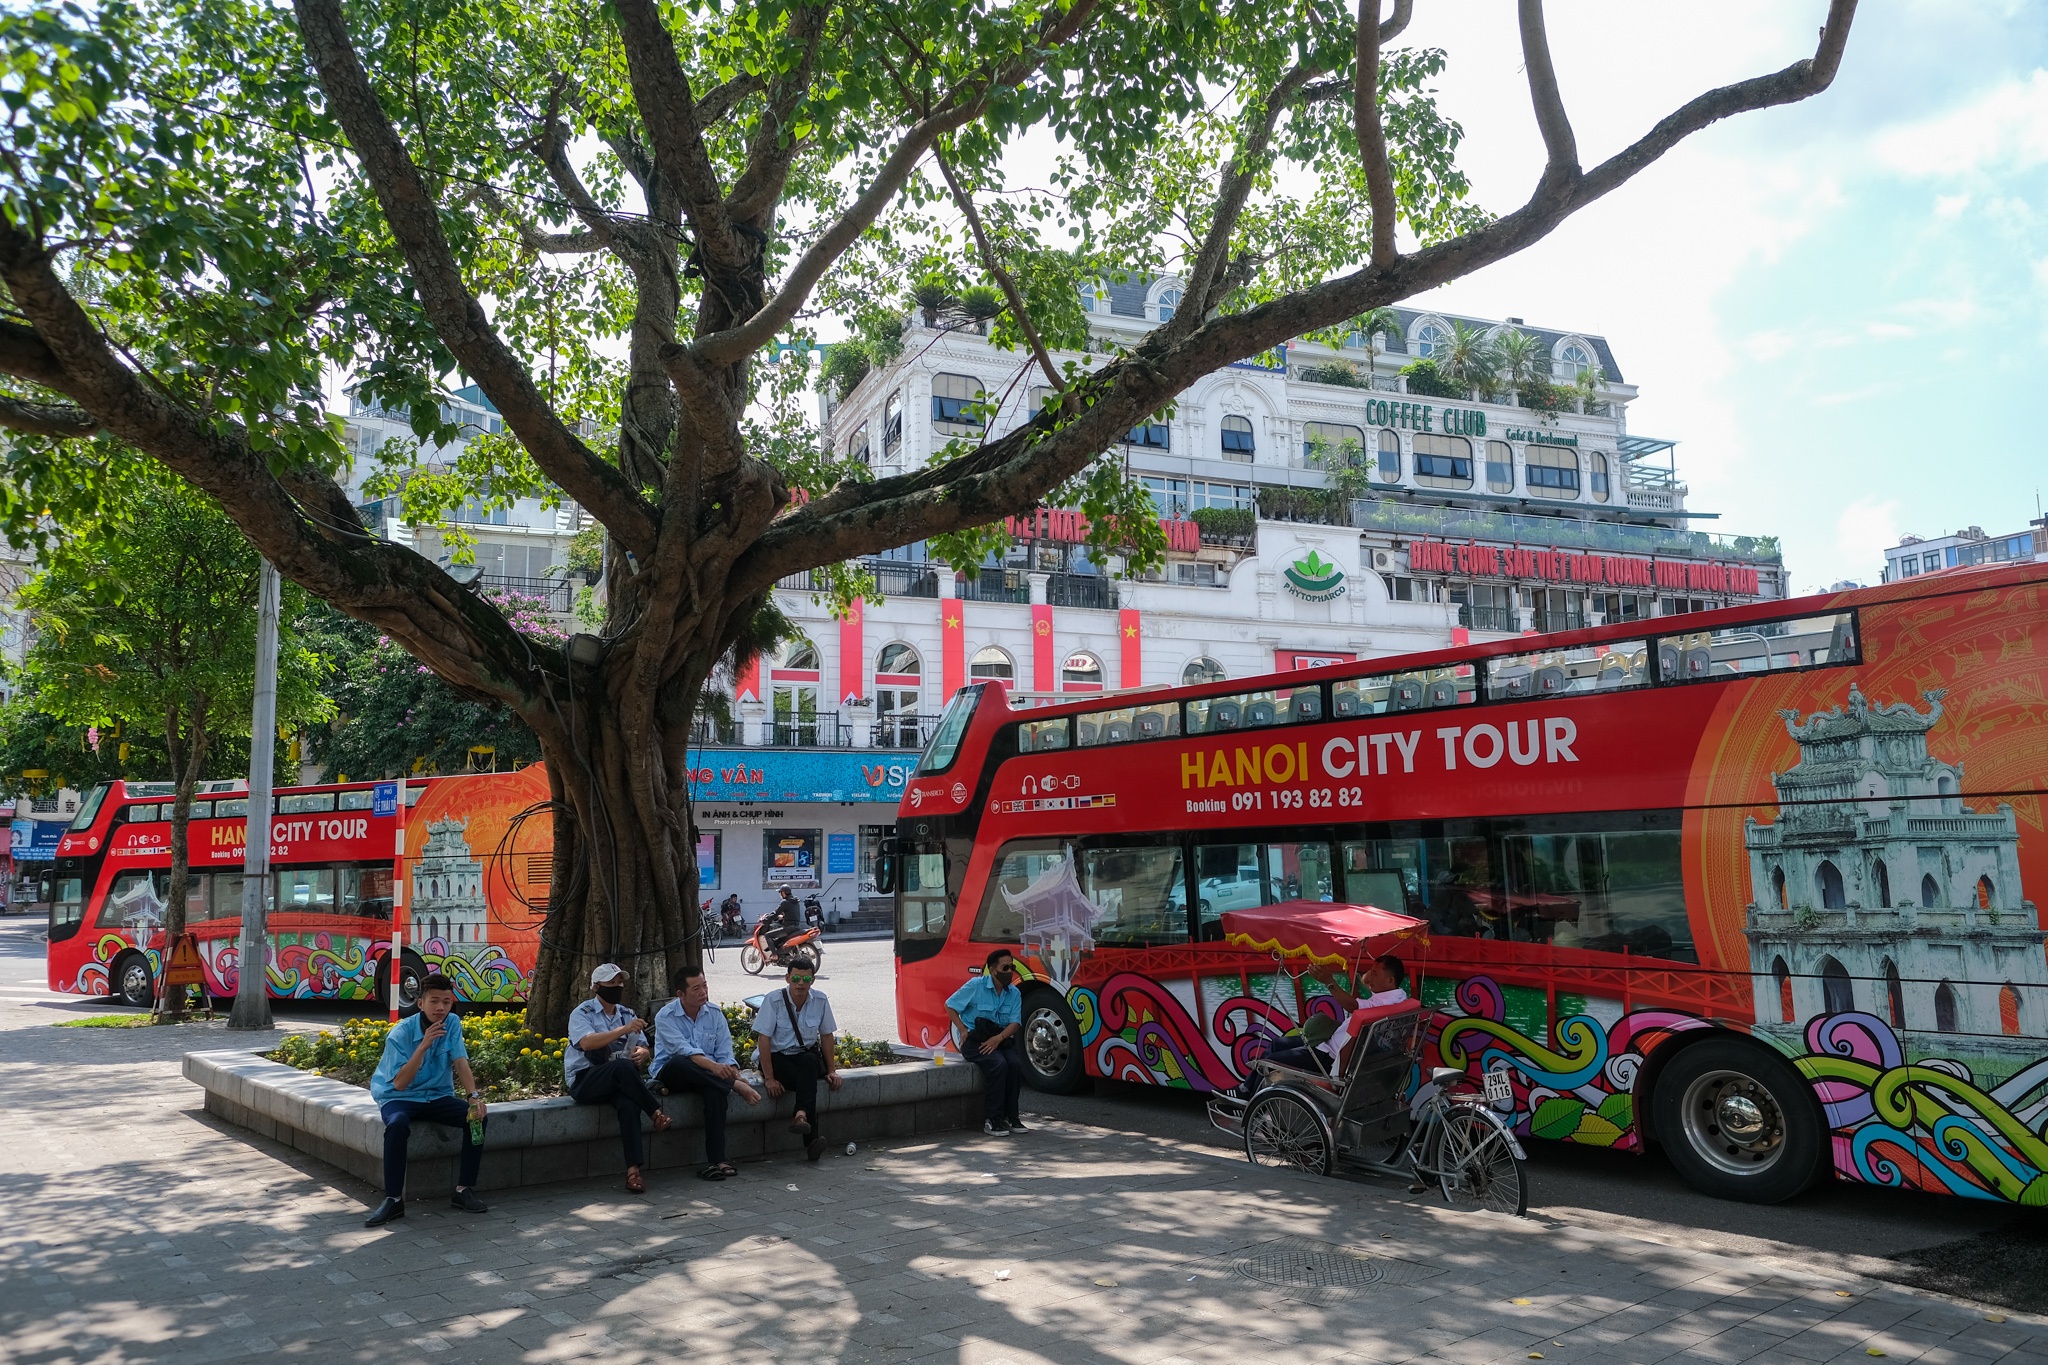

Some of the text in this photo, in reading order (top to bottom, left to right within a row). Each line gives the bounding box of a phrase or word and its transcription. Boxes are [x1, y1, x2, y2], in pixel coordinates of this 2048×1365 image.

[1366, 399, 1487, 437] COFFEE CLUB
[1506, 428, 1579, 447] Café & Restaurant
[1409, 533, 1453, 573] ĐẢNG
[1457, 538, 1499, 579] CỘNG
[1503, 540, 1535, 578] SẢN
[1536, 545, 1567, 585] VIỆT
[1570, 552, 1603, 584] NAM
[1604, 555, 1651, 587] QUANG
[1653, 560, 1687, 590] VINH
[1687, 558, 1728, 593] MUÔN
[1283, 582, 1346, 603] PHYTOPHARCO
[1180, 716, 1580, 789] HANOI CITY TOUR
[721, 763, 764, 784] VÂN
[1186, 786, 1363, 813] Booking 091 193 82 82
[211, 818, 368, 846] HAN CITY TOUR
[211, 851, 230, 859] Booking
[278, 845, 289, 856] 82
[1487, 1072, 1506, 1087] 29XL
[1487, 1085, 1511, 1100] 0116
